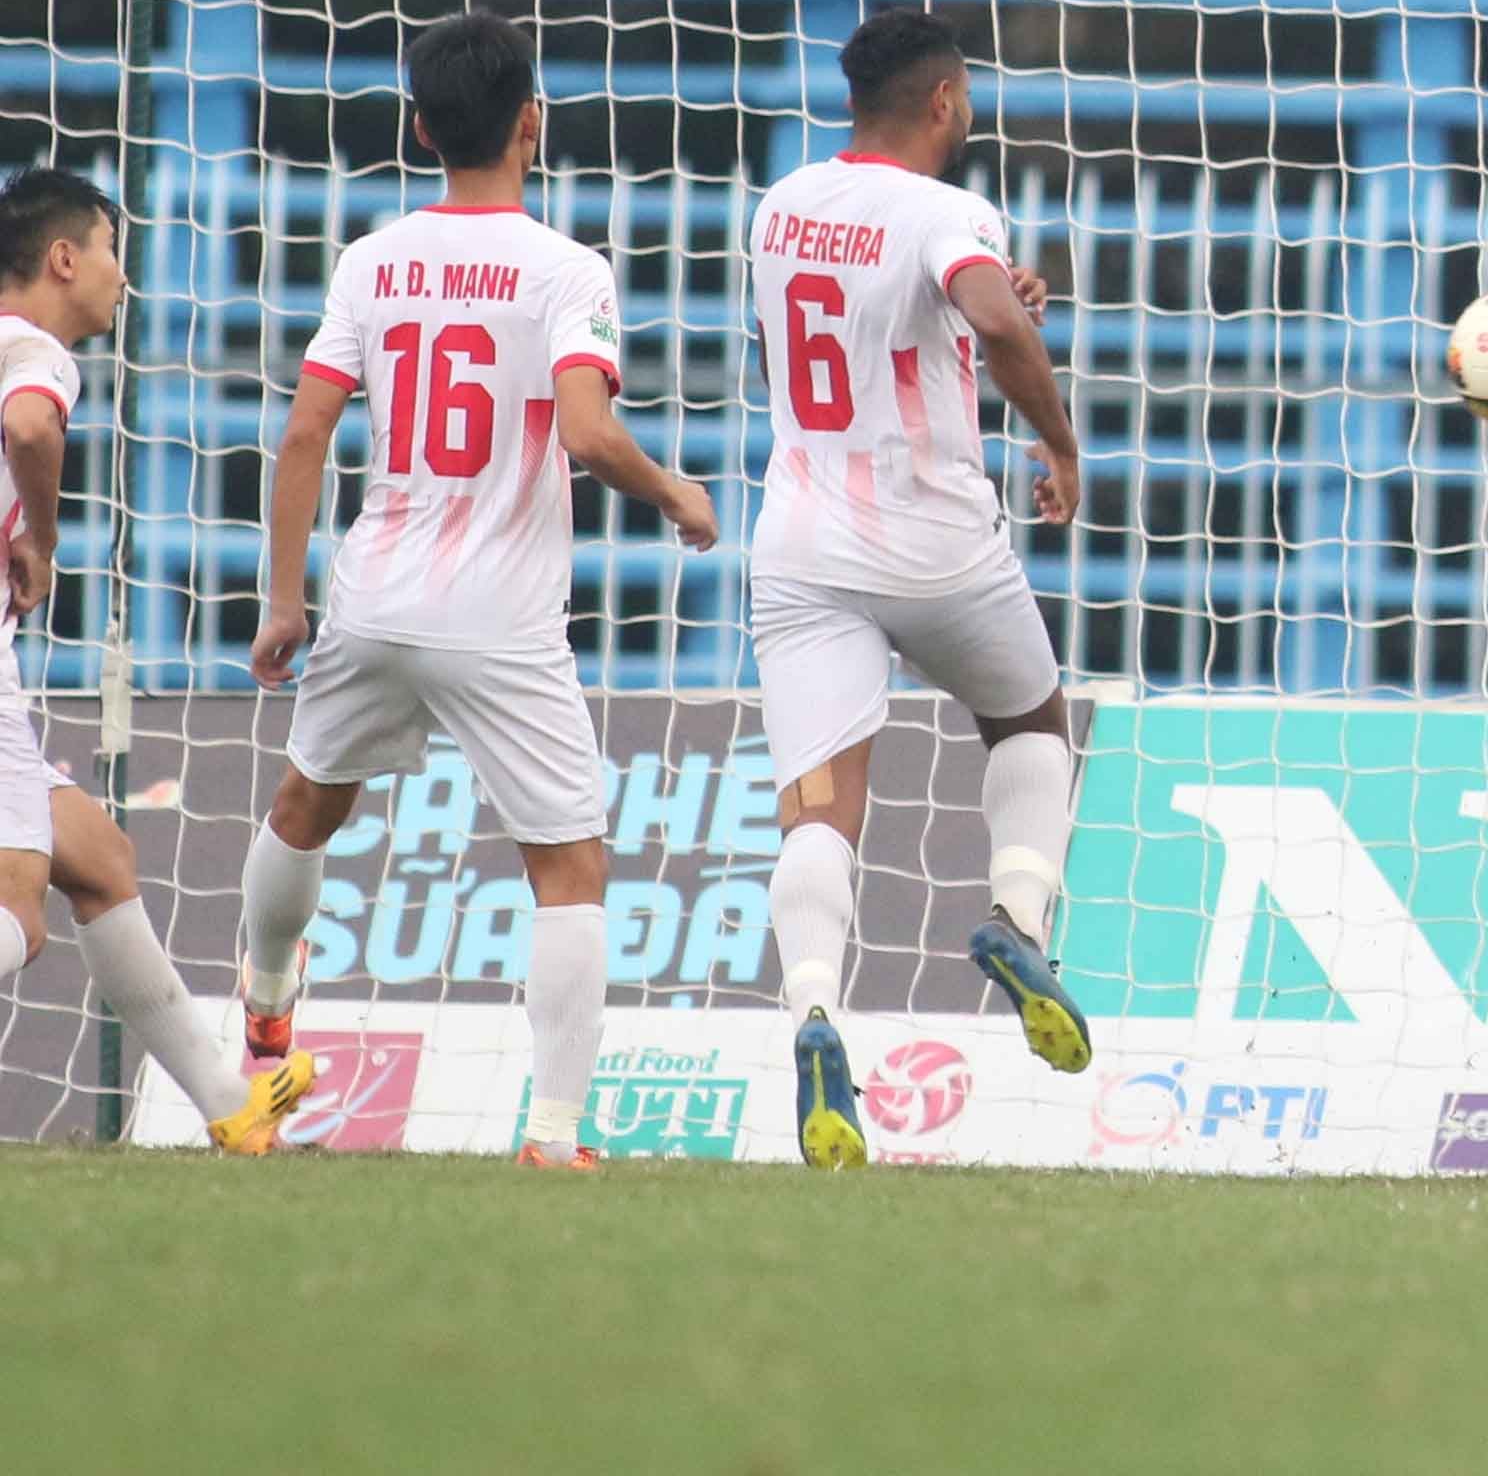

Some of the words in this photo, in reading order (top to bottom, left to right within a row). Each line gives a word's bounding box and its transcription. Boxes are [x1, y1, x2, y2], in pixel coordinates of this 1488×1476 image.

[375, 264, 398, 300] N.
[442, 264, 520, 308] MẠNH
[785, 272, 854, 433] 6
[384, 321, 496, 478] 16
[593, 1084, 743, 1138] UTI
[1200, 1084, 1328, 1140] PTI
